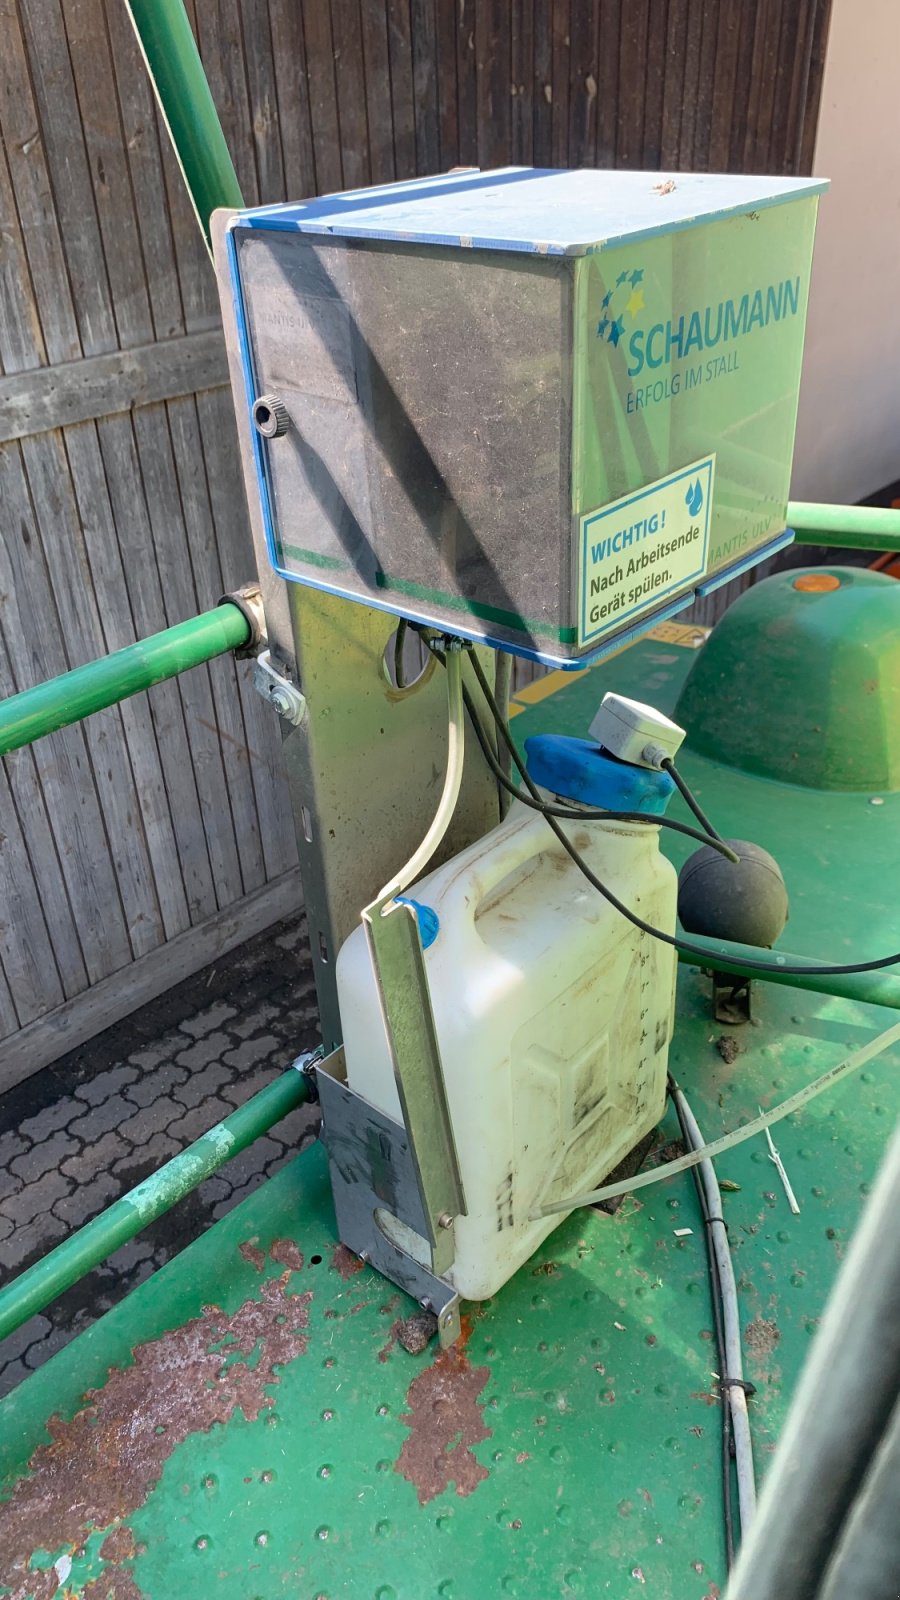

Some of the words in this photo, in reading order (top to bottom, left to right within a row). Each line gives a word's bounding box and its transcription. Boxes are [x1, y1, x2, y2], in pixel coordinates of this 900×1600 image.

[627, 275, 800, 377] SCHAUMANN
[626, 374, 681, 414] ERFOLG
[684, 365, 703, 391] IM
[705, 351, 739, 382] STALL
[590, 566, 623, 597] Nach
[626, 525, 700, 578] Arbeitsende
[589, 594, 626, 624] Gerät
[627, 568, 673, 603] spülen.
